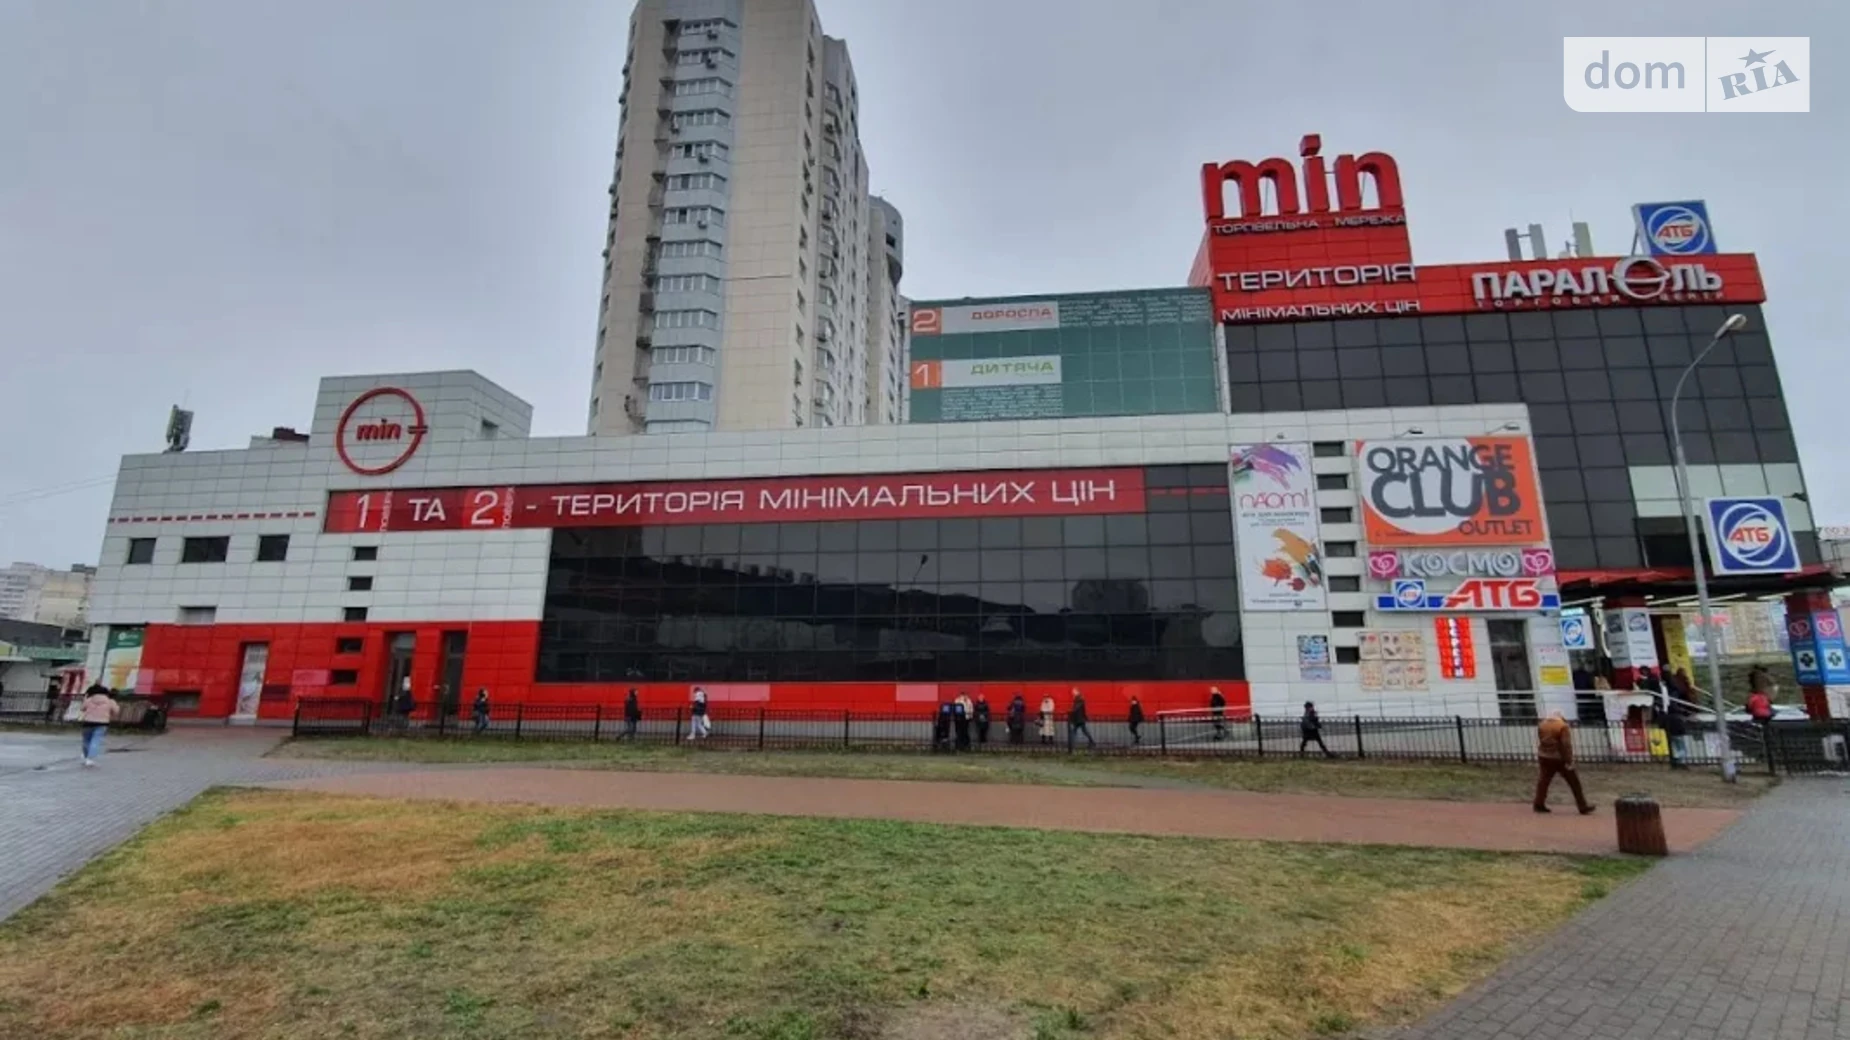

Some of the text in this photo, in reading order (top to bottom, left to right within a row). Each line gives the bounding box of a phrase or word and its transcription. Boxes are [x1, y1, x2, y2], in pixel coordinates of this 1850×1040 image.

[1201, 134, 1404, 219] min
[1335, 214, 1407, 227] МЕРЕЖА
[1657, 224, 1695, 238] АТБ
[1218, 264, 1416, 291] ТЕРИТОРІЯ
[912, 308, 937, 332] 2
[1221, 301, 1378, 321] МІНІМАЛЬНИХ
[1385, 299, 1421, 315] ЦІН
[914, 361, 1054, 387] 1 ДИТЯЧА
[357, 418, 401, 441] min
[1366, 444, 1515, 473] ORANGE
[357, 494, 370, 528] 1
[408, 497, 446, 521] ТА
[471, 490, 499, 525] 2
[551, 489, 744, 516] ТЕРИТОРІЯ
[759, 480, 1036, 511] МІНІМАЛЬНИХ
[1051, 479, 1116, 505] ЦІН
[1371, 470, 1521, 518] CLUB
[1457, 518, 1534, 536] OUTLET
[1729, 526, 1770, 543] АТБ
[1402, 552, 1520, 577] КОСМО
[1444, 579, 1542, 609] АТБ
